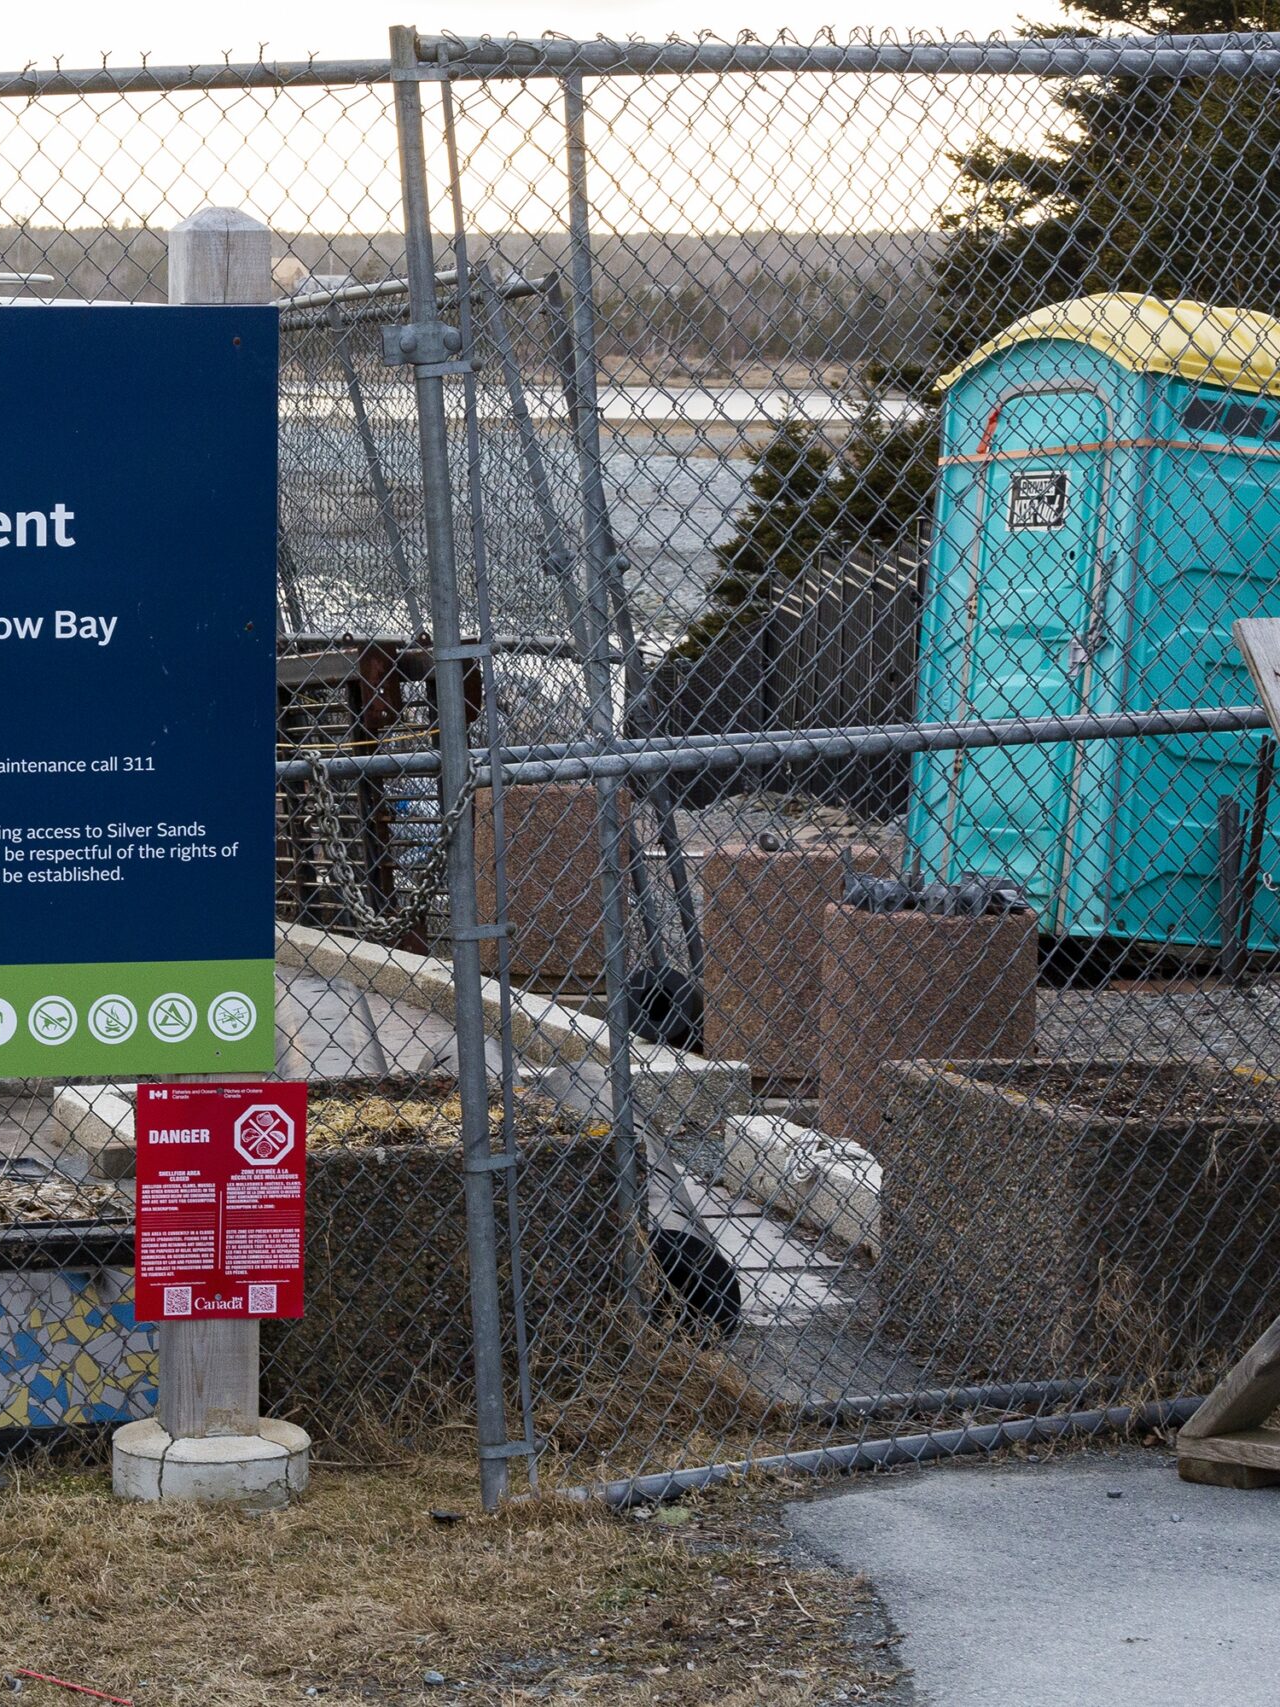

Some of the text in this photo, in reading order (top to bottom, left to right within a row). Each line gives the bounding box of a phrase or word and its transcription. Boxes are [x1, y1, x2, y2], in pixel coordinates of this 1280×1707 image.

[55, 610, 118, 647] Bay
[90, 756, 118, 772] call
[123, 756, 156, 772] 311
[26, 827, 81, 840] access
[84, 824, 103, 839] to
[107, 822, 153, 838] Silver
[157, 821, 206, 838] Sands
[4, 846, 25, 862] be
[29, 844, 112, 864] respectful
[116, 843, 135, 860] of
[138, 843, 166, 859] the
[170, 842, 217, 862] rights
[221, 841, 239, 858] of
[2, 867, 23, 883] be
[27, 865, 125, 883] established.
[149, 1129, 210, 1144] DANGER
[194, 1296, 243, 1310] Canada
